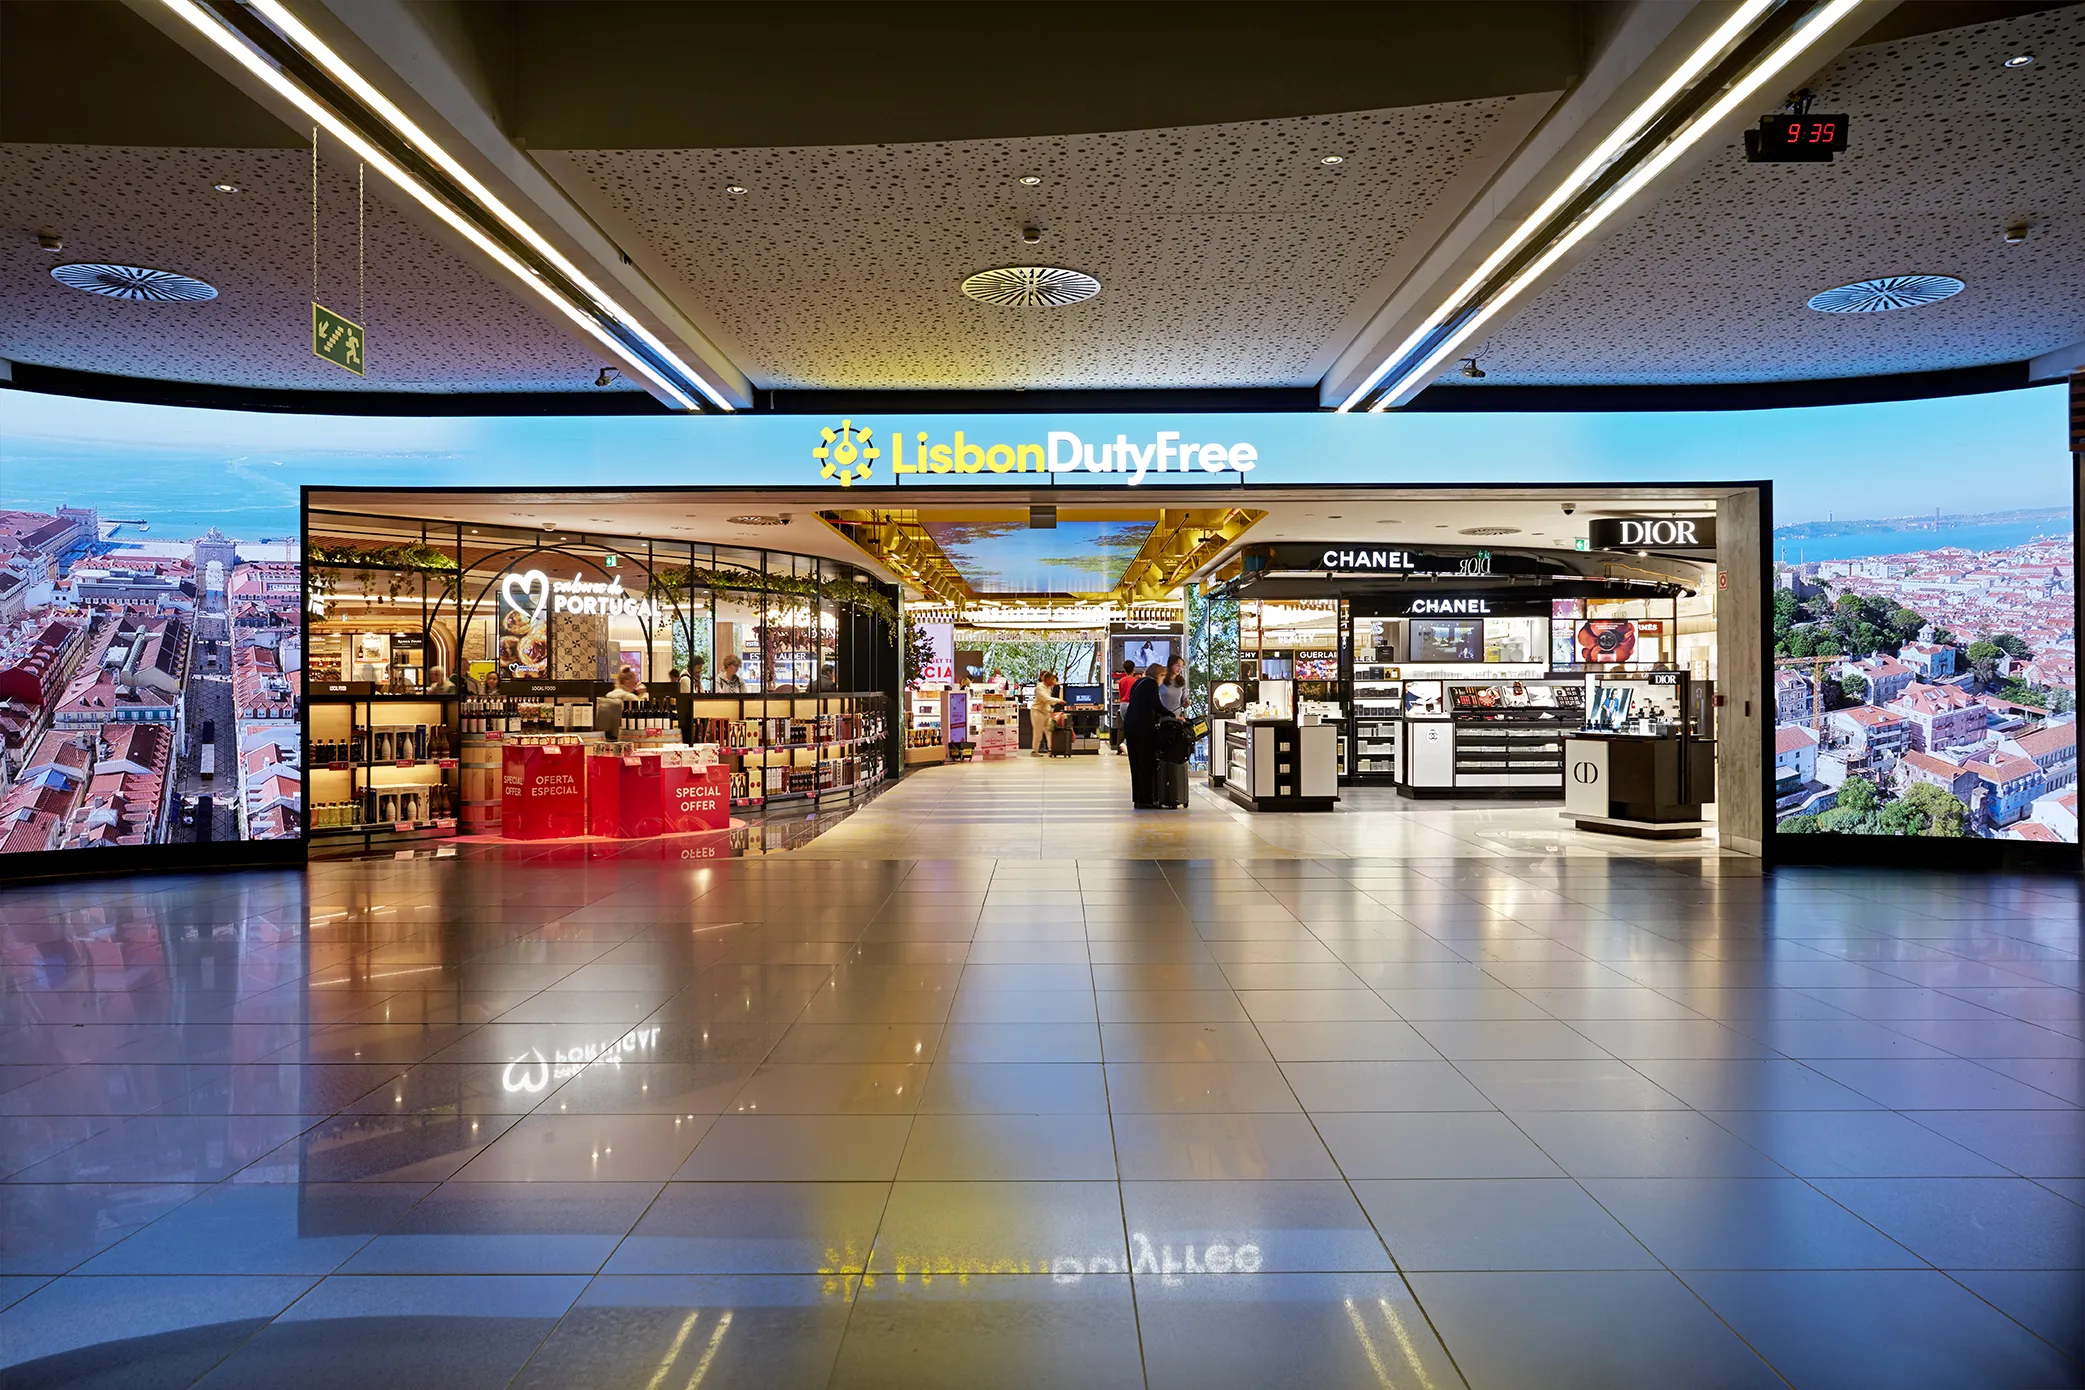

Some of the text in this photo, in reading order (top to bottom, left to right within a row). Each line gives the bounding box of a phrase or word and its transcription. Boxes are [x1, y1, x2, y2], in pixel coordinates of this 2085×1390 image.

[892, 431, 1258, 485] LisbonDutyFree
[1619, 520, 1699, 545] DIOR
[1323, 550, 1415, 568] CHANEL
[554, 594, 662, 617] PORTUGAL
[1411, 599, 1491, 614] CHANEL
[1638, 623, 1658, 631] RMÈS
[1240, 651, 1257, 659] CHY
[1655, 674, 1677, 685] DIOR
[503, 774, 524, 786] SPECIAL
[535, 774, 574, 785] OFERTA
[505, 786, 522, 797] OFFER
[531, 786, 578, 797] ESPECIAL
[675, 786, 721, 798] SPECIAL
[680, 800, 716, 812] OFFER
